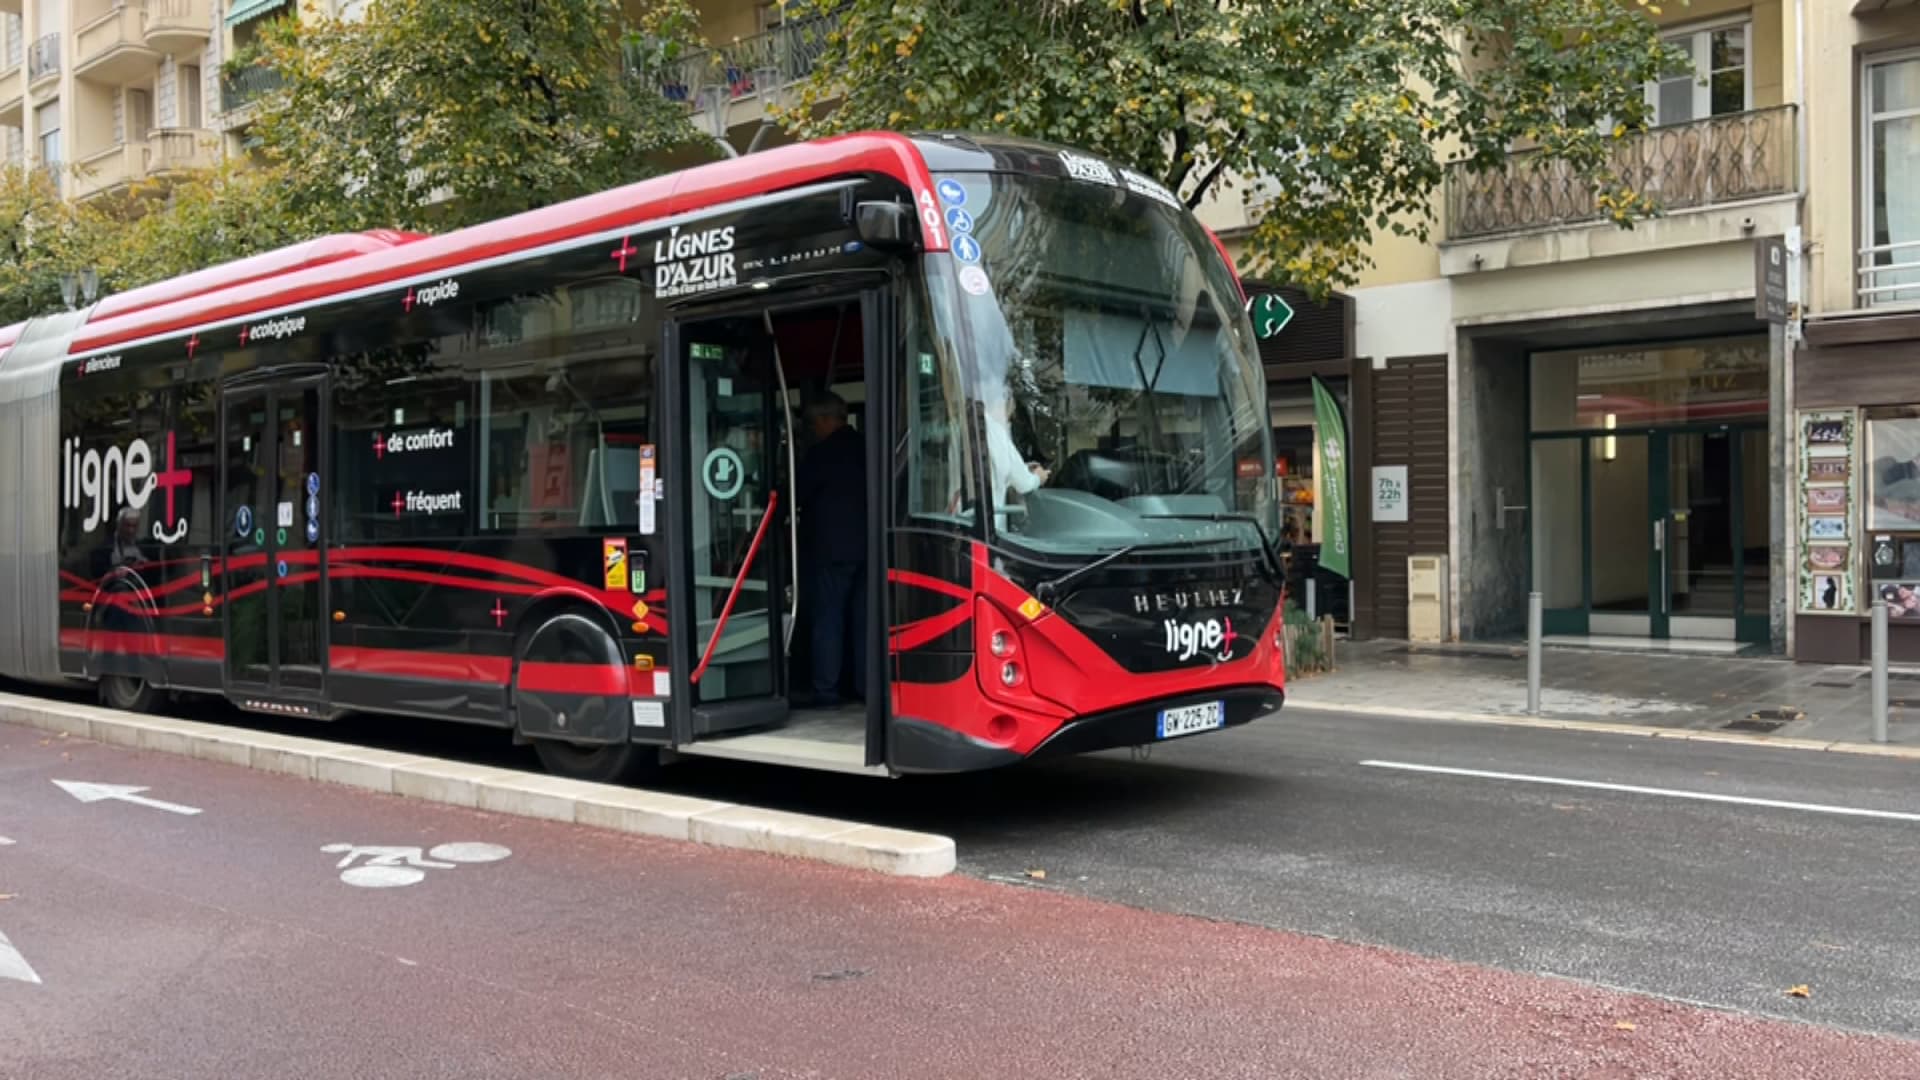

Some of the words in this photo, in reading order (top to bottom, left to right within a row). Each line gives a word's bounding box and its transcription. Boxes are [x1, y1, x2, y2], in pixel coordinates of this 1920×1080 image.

[920, 189, 943, 248] 401
[654, 226, 736, 263] LIGNES
[655, 252, 737, 287] D'AZUR
[416, 278, 459, 306] rapide
[387, 432, 403, 452] de
[406, 428, 453, 451] confort
[406, 490, 462, 515] fréquent
[1379, 488, 1401, 499] 22h
[1134, 588, 1243, 612] HEULIEZ
